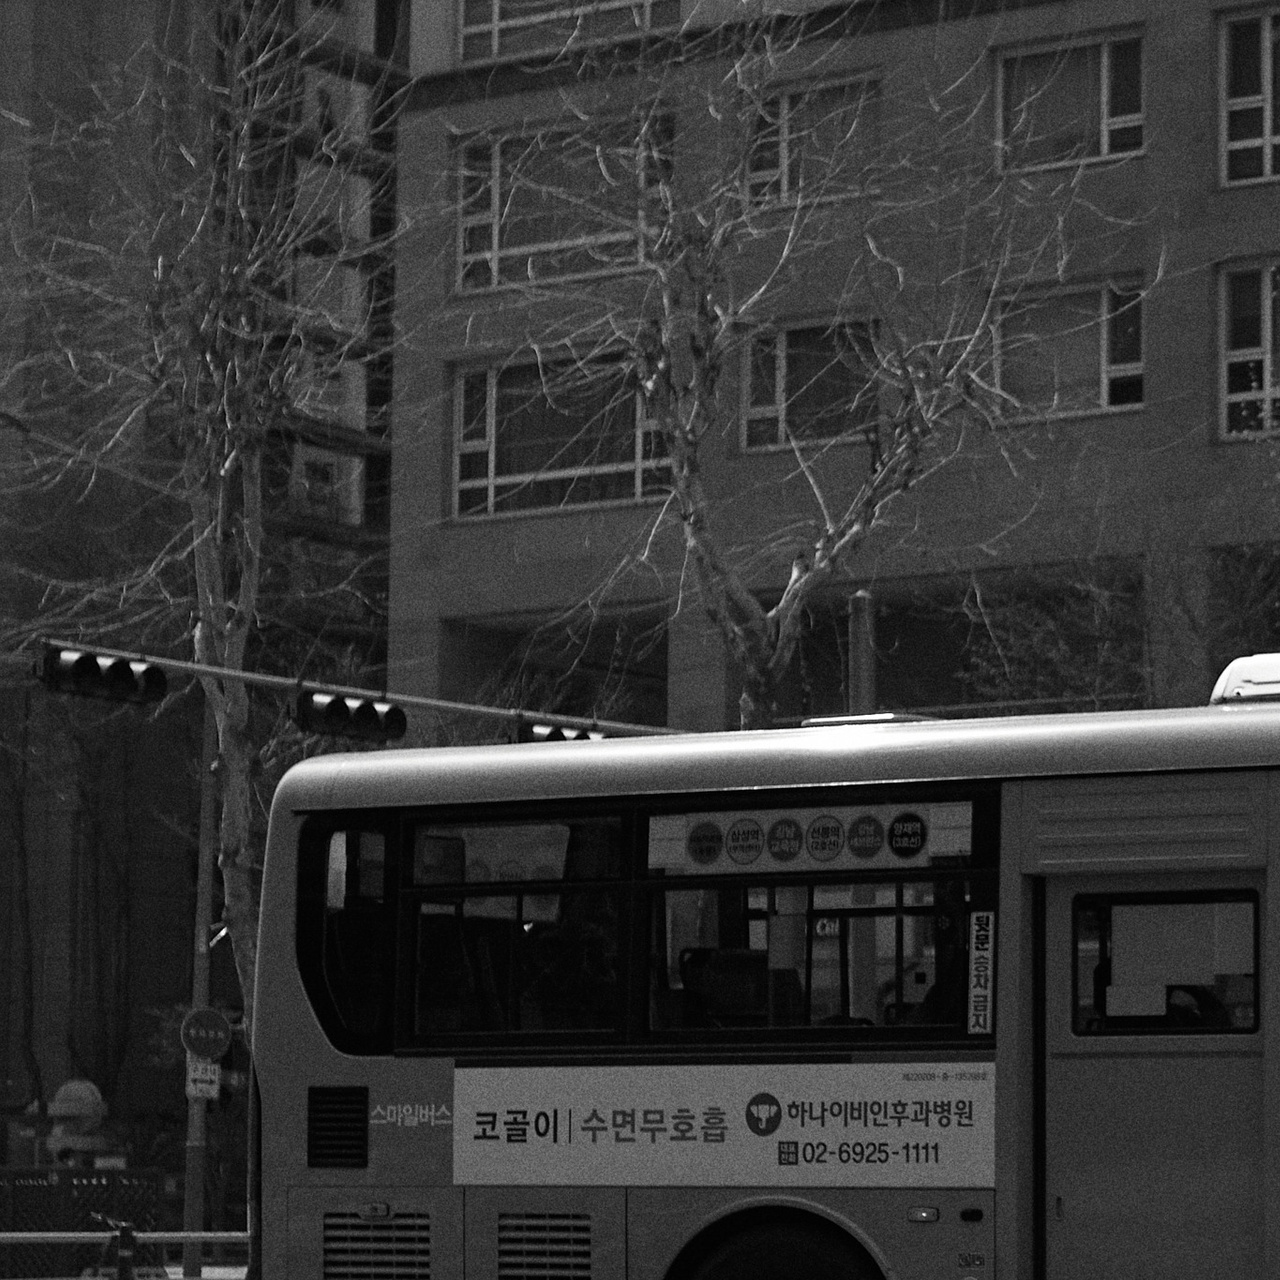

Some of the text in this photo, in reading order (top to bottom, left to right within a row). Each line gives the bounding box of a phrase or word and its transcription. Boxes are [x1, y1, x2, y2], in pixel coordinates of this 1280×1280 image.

[971, 915, 990, 1030] 뒷문 승차 금지
[369, 1102, 453, 1127] 스마일버스
[473, 1107, 729, 1144] 코골이 수면무호흡
[787, 1097, 974, 1128] 하나이비인후과병원
[802, 1142, 940, 1164] 02-6925-1111
